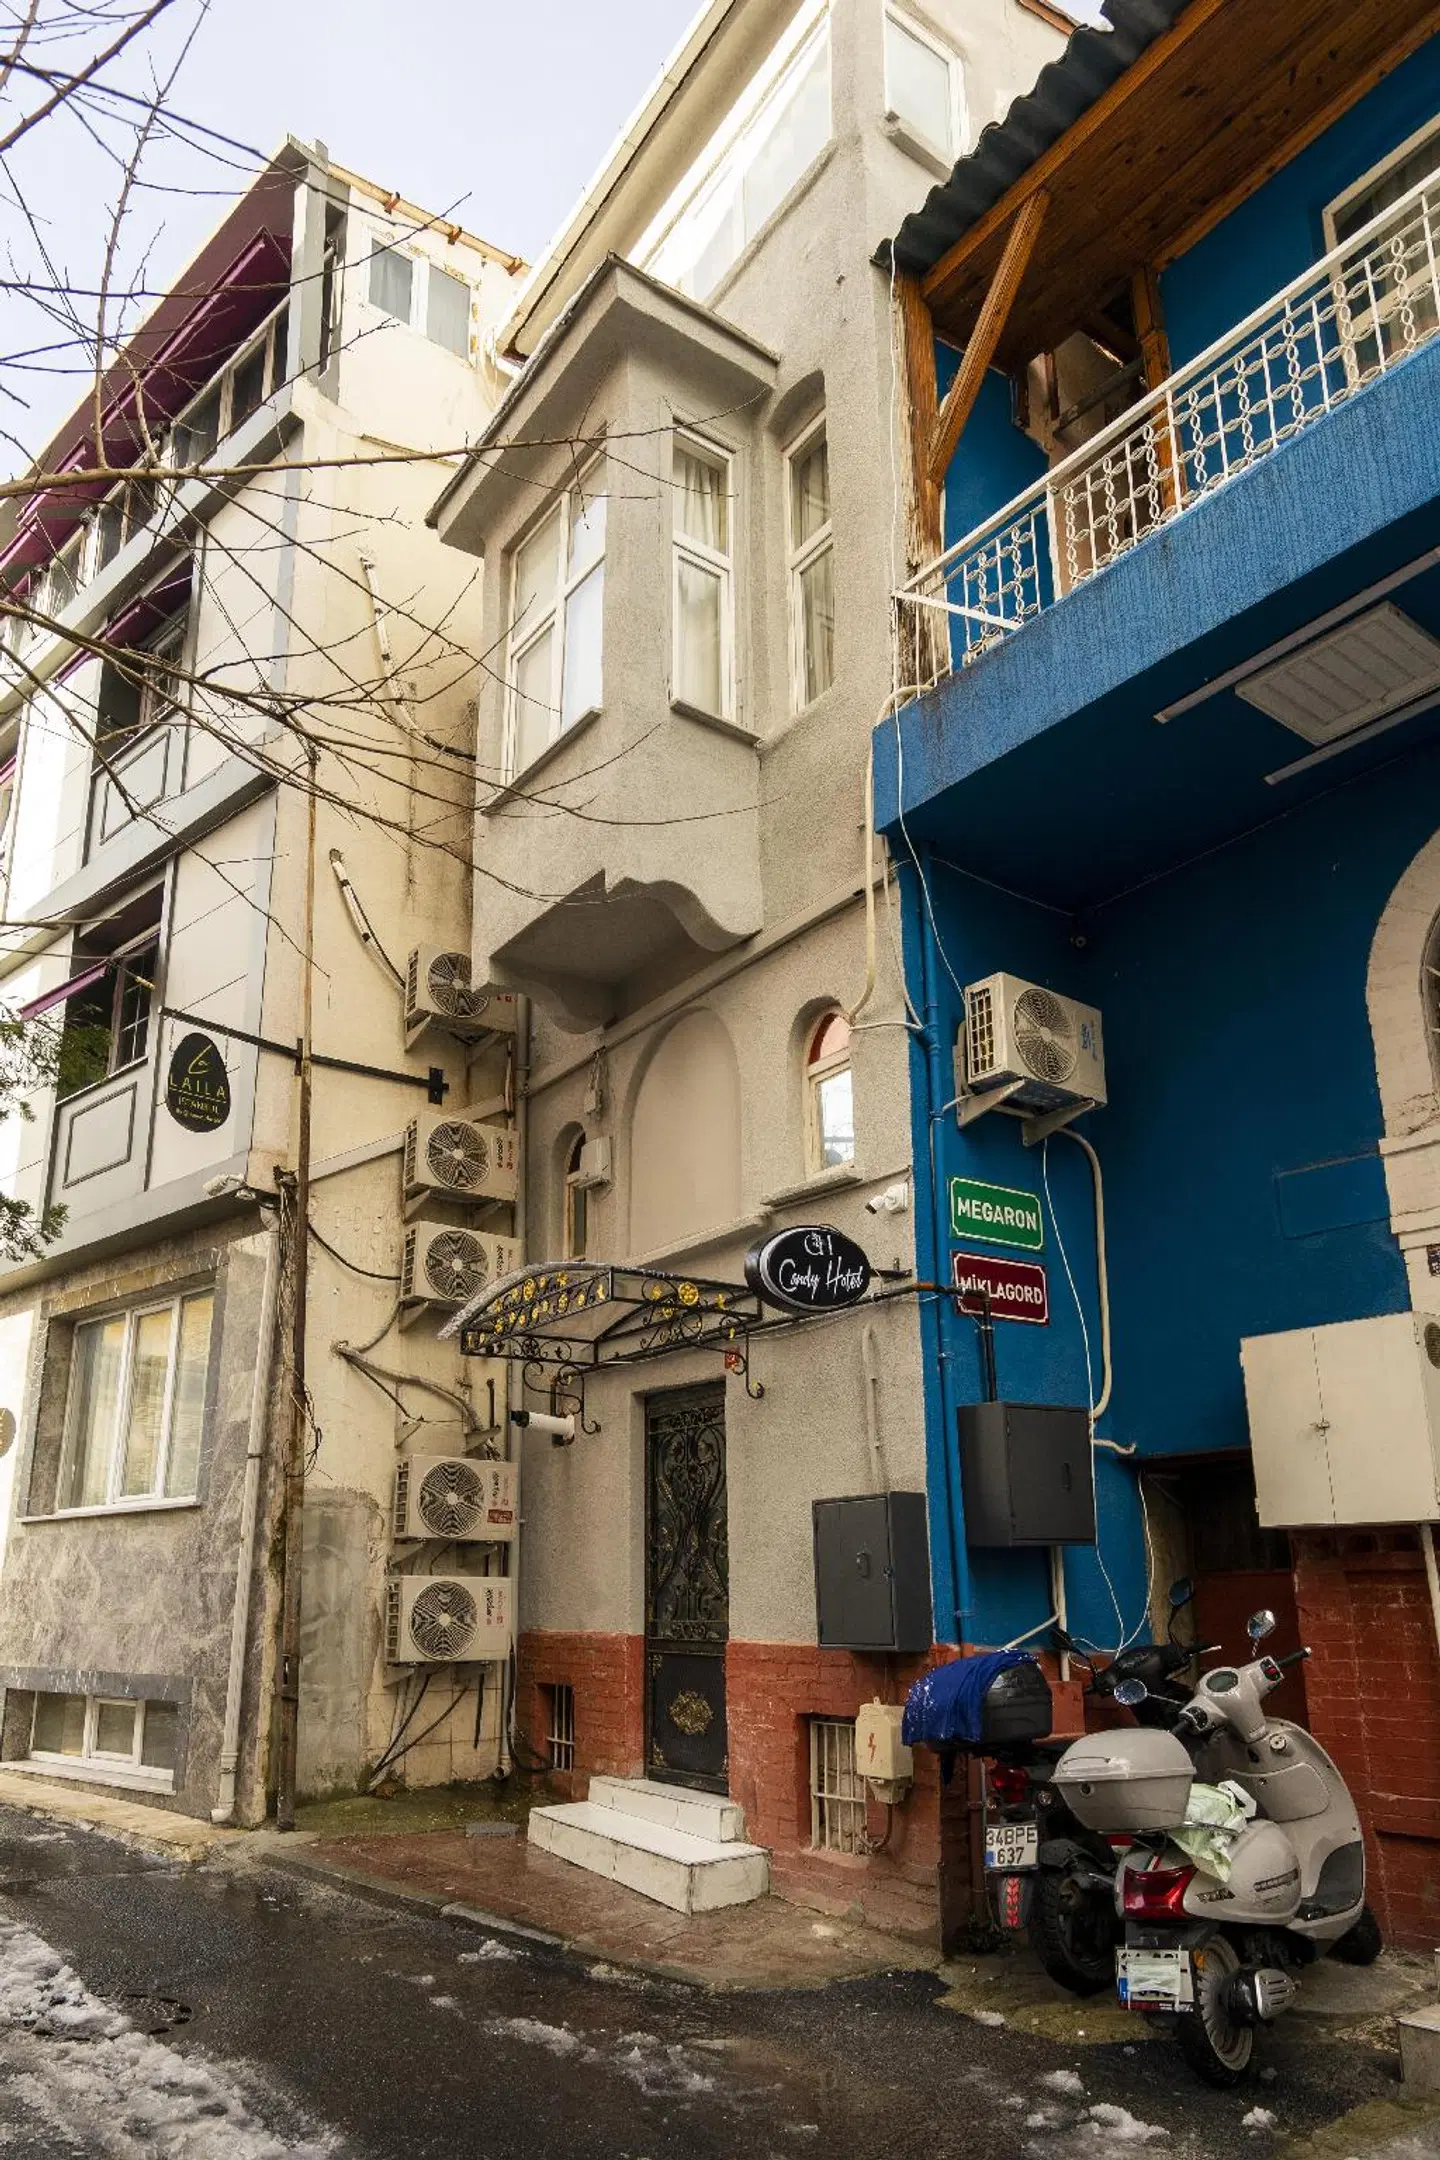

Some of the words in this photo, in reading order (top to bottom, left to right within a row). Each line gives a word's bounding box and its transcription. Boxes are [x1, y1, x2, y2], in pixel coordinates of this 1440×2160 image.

[170, 1074, 226, 1099] LAILA
[957, 1196, 1037, 1231] MEGARON
[779, 1258, 820, 1300] Candy
[826, 1256, 864, 1297] Hotel
[997, 1846, 1025, 1864] 637
